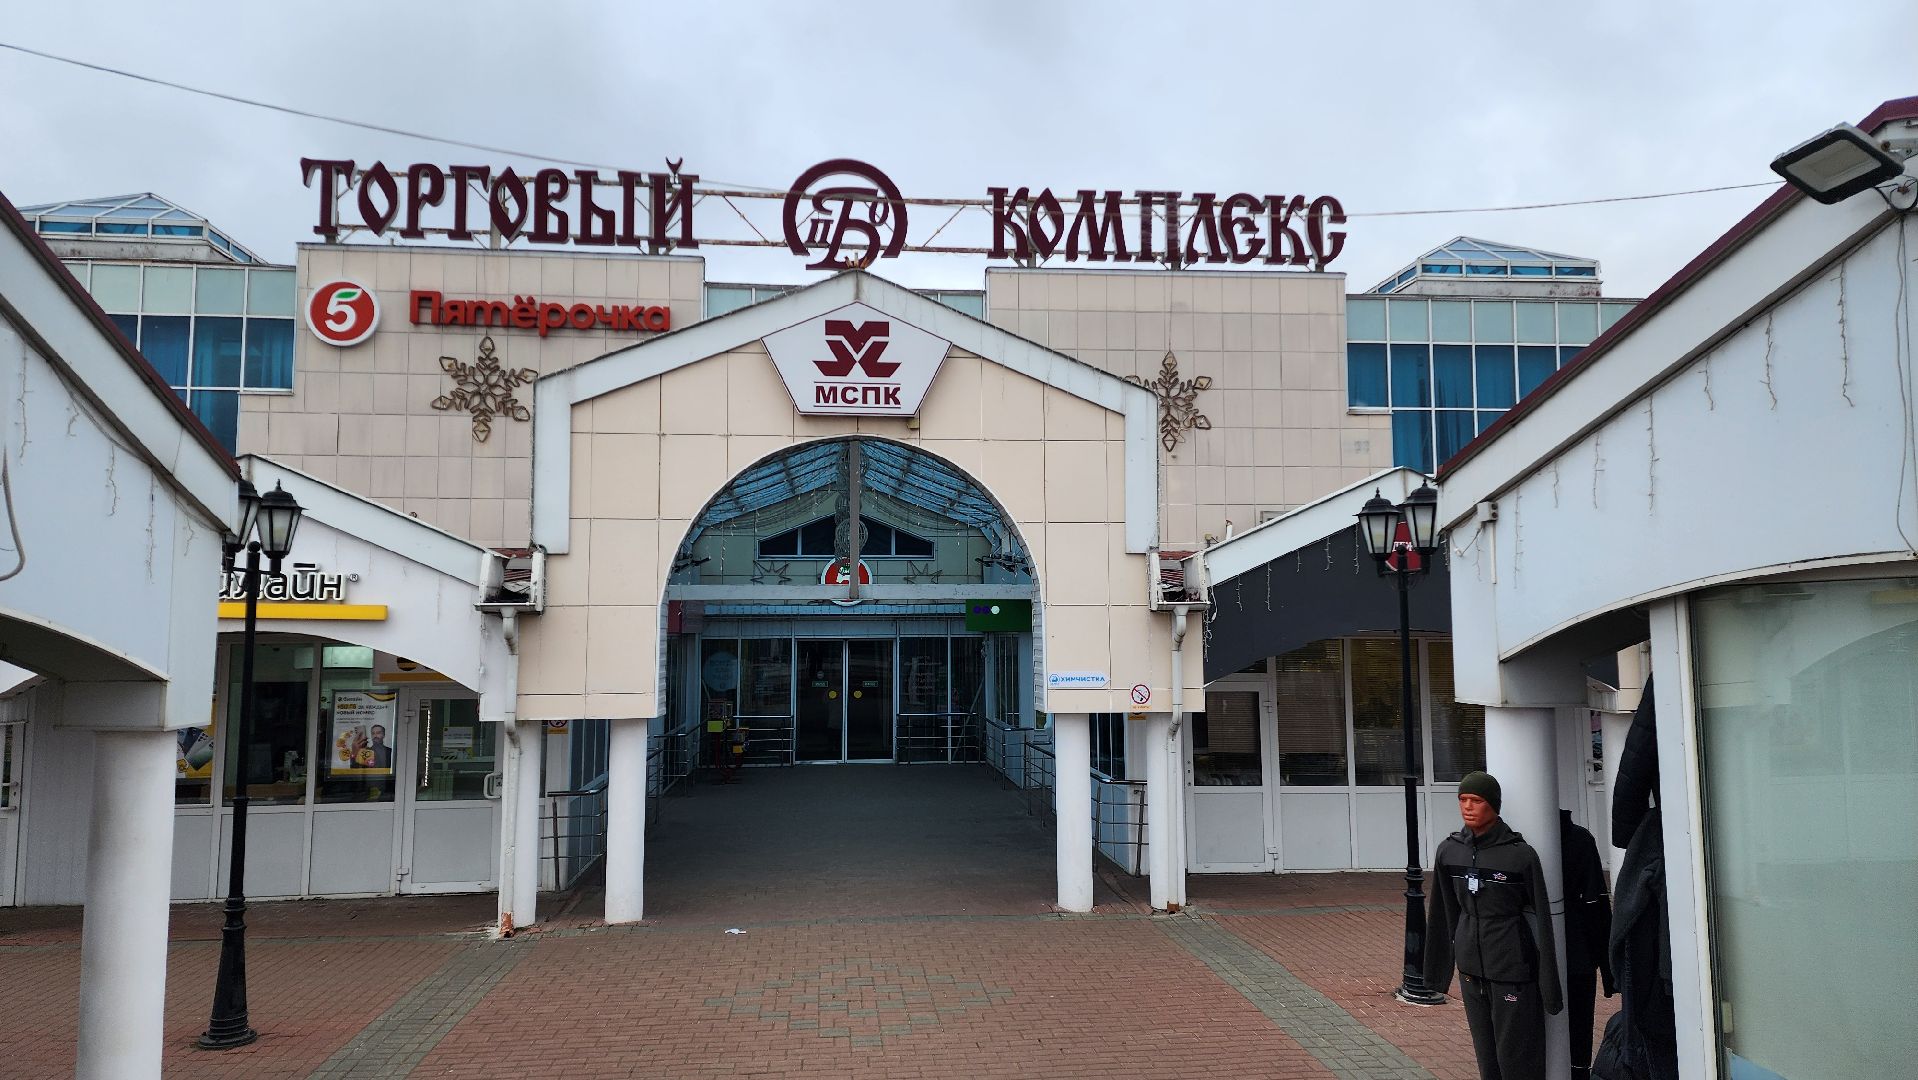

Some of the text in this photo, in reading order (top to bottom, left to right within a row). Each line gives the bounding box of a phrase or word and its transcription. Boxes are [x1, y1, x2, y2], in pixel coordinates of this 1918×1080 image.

[300, 157, 1348, 267] ТОРГОВЫЙ КОМПЛЕКС
[324, 289, 361, 333] 5
[409, 290, 671, 337] Пятёрочка
[815, 385, 902, 406] МСПК
